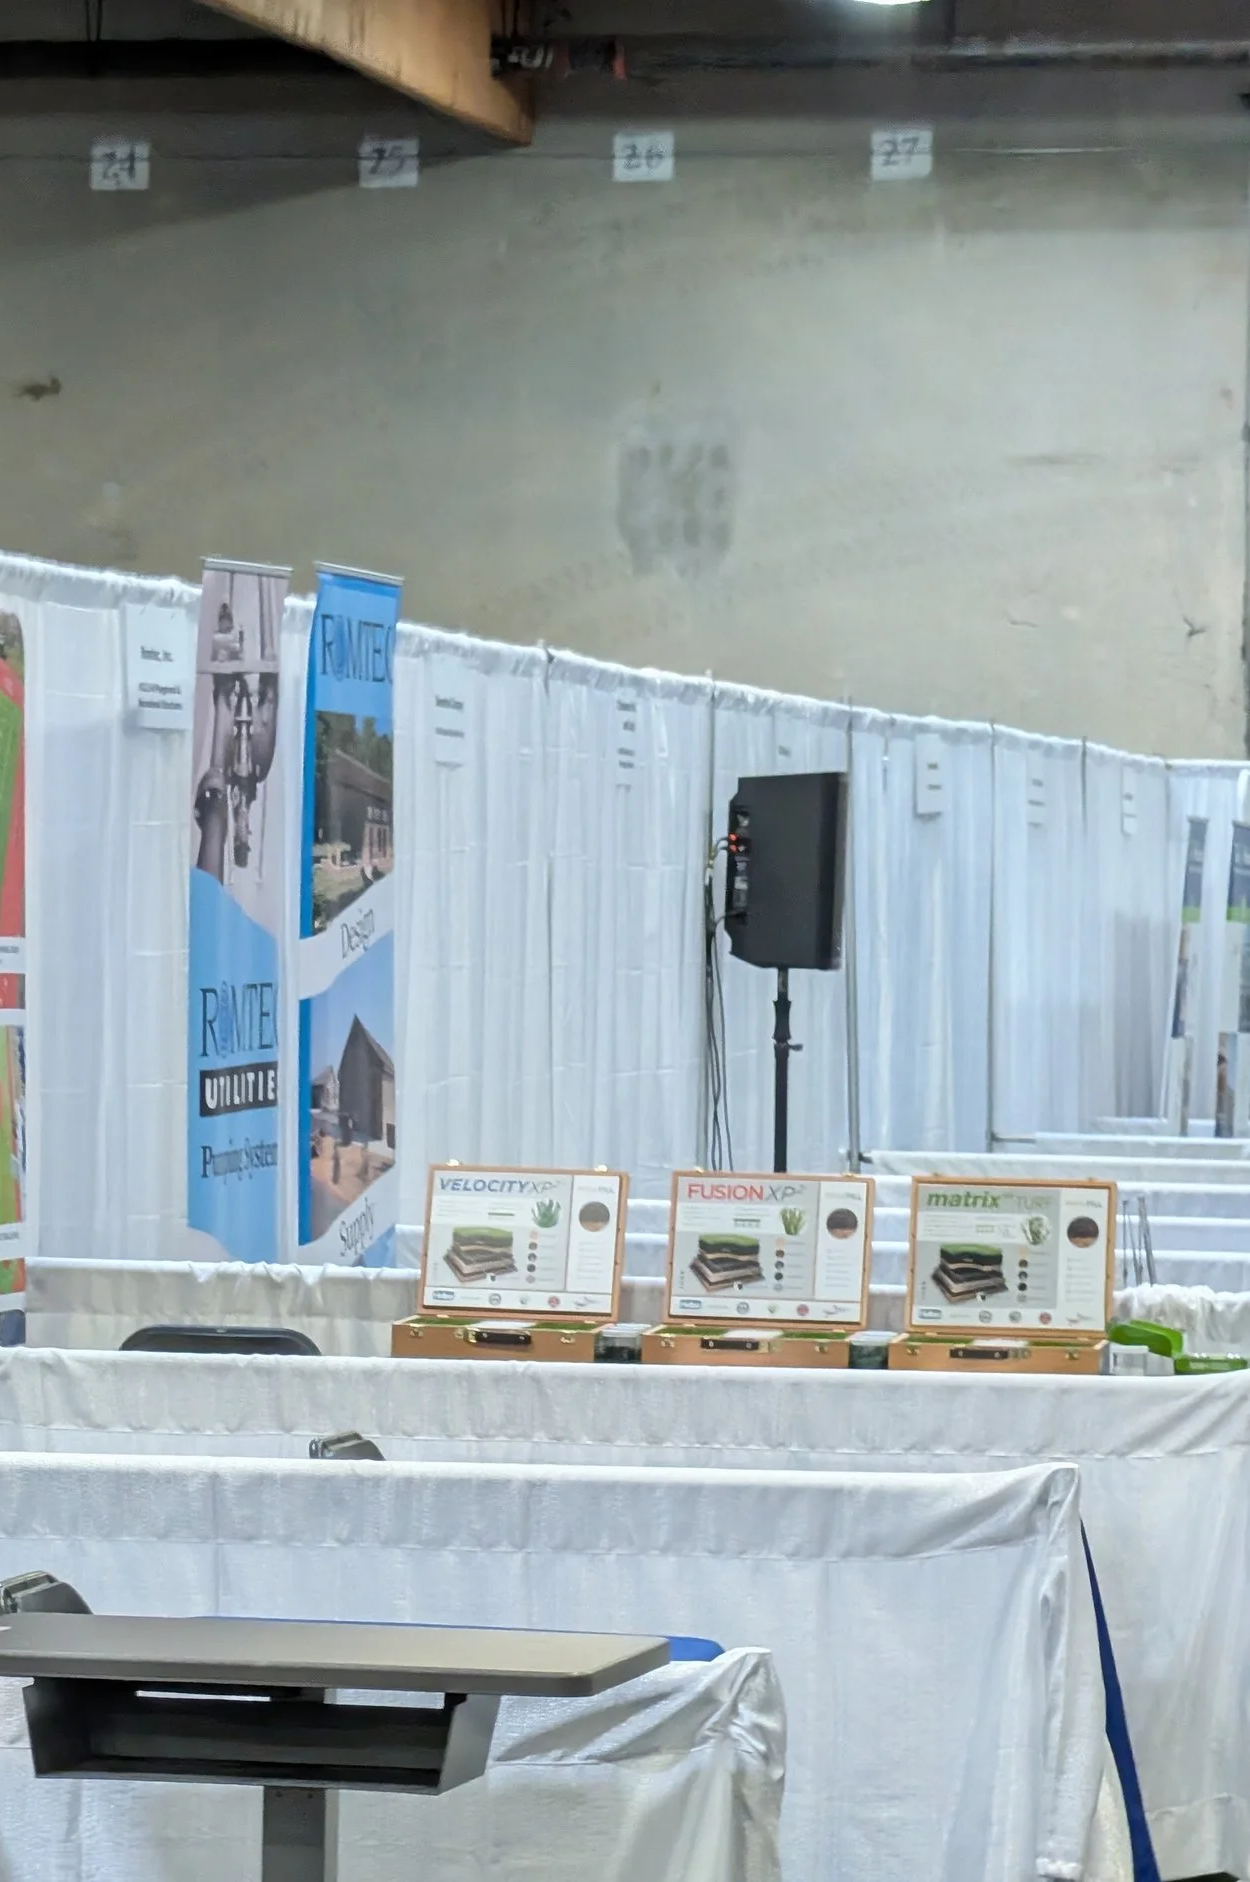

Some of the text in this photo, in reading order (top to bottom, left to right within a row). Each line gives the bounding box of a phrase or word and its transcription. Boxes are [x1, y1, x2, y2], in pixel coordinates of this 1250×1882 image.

[882, 135, 920, 166] 27
[199, 980, 278, 1058] ROMTE
[205, 1068, 279, 1109] UTILITIE
[926, 1191, 1000, 1209] matrix
